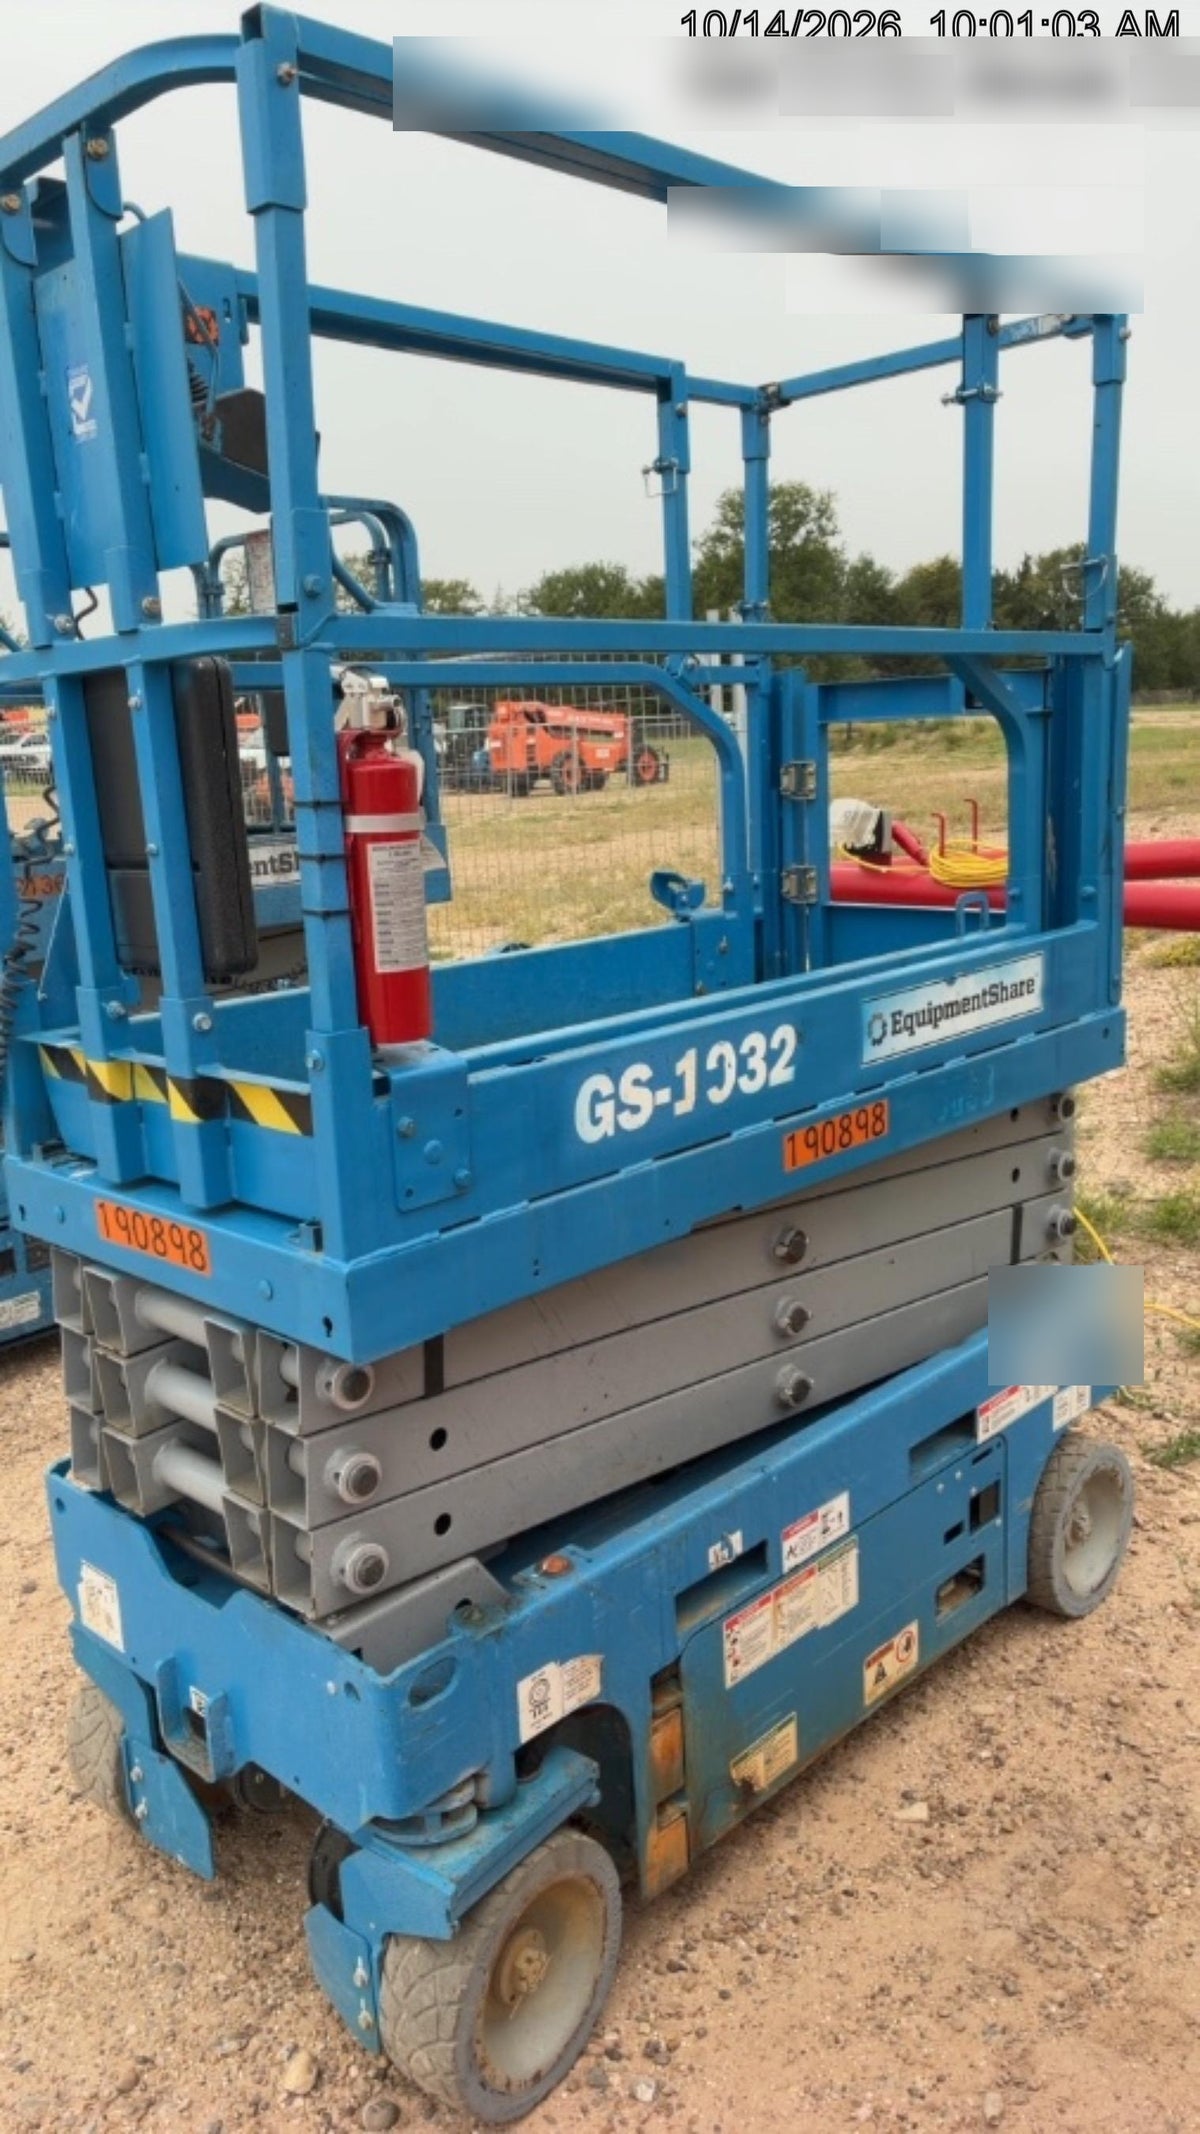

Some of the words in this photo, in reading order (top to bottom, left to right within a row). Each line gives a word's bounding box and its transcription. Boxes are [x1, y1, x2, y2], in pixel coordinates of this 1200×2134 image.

[890, 977, 1036, 1037] EquipmentShare
[574, 1023, 798, 1145] GS-1032
[786, 1101, 886, 1168] 190898
[97, 1201, 208, 1272] 190898
